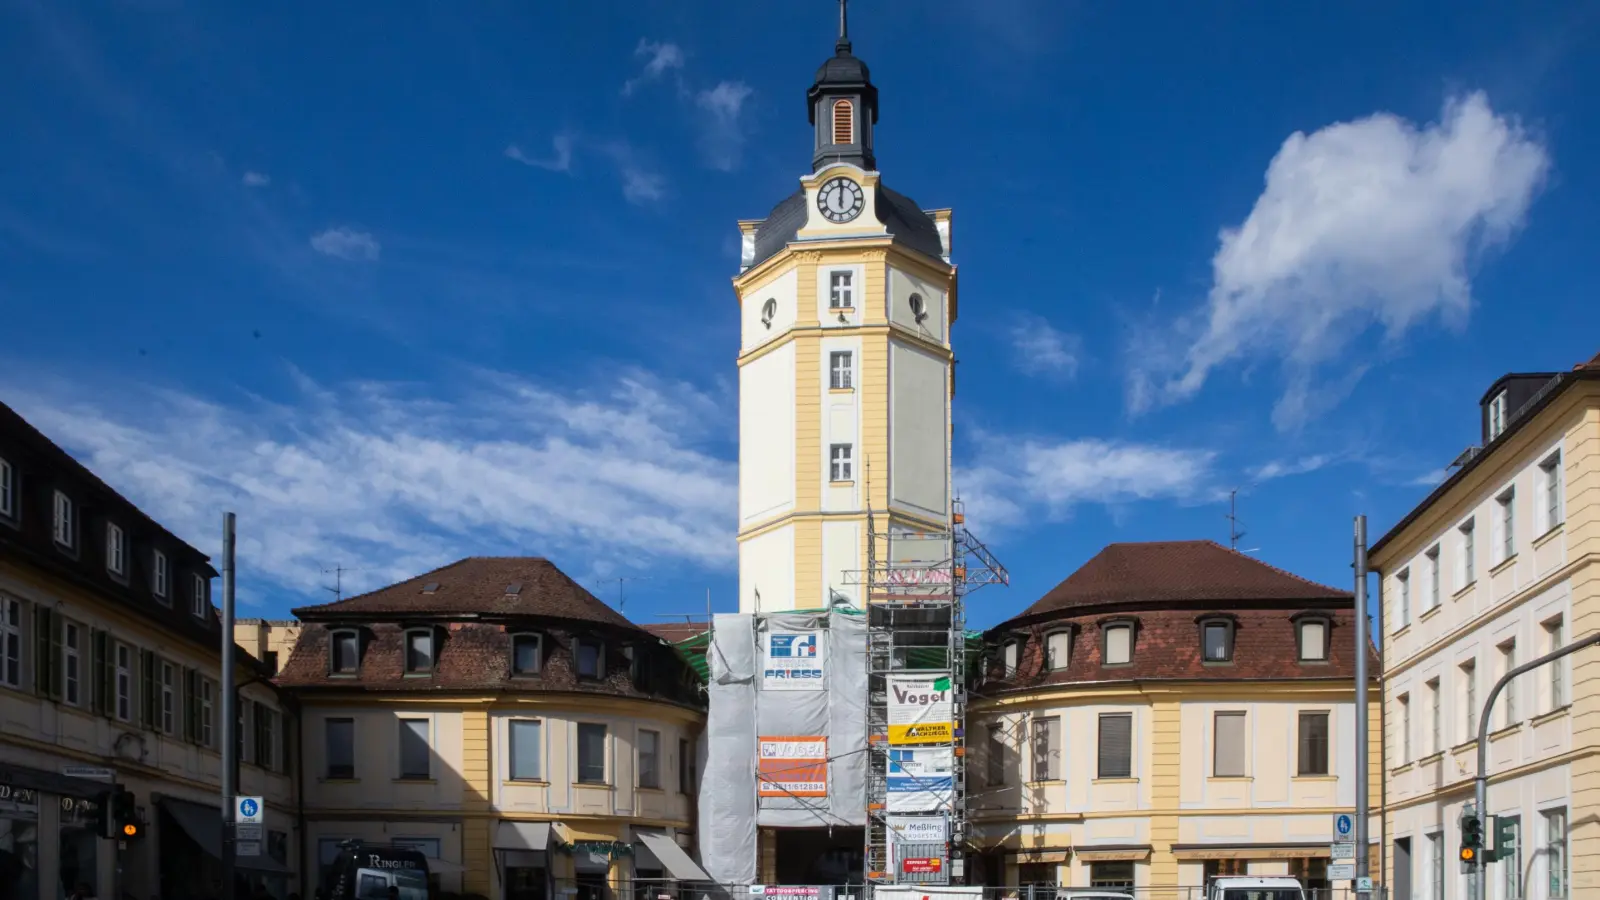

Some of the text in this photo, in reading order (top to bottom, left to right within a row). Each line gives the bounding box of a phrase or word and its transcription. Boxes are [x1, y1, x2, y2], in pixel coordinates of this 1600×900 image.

[764, 669, 822, 679] FRIESS
[892, 684, 946, 706] Vogel
[776, 743, 824, 757] VOGEL
[909, 823, 942, 833] Meßling
[368, 854, 416, 868] RINGLER
